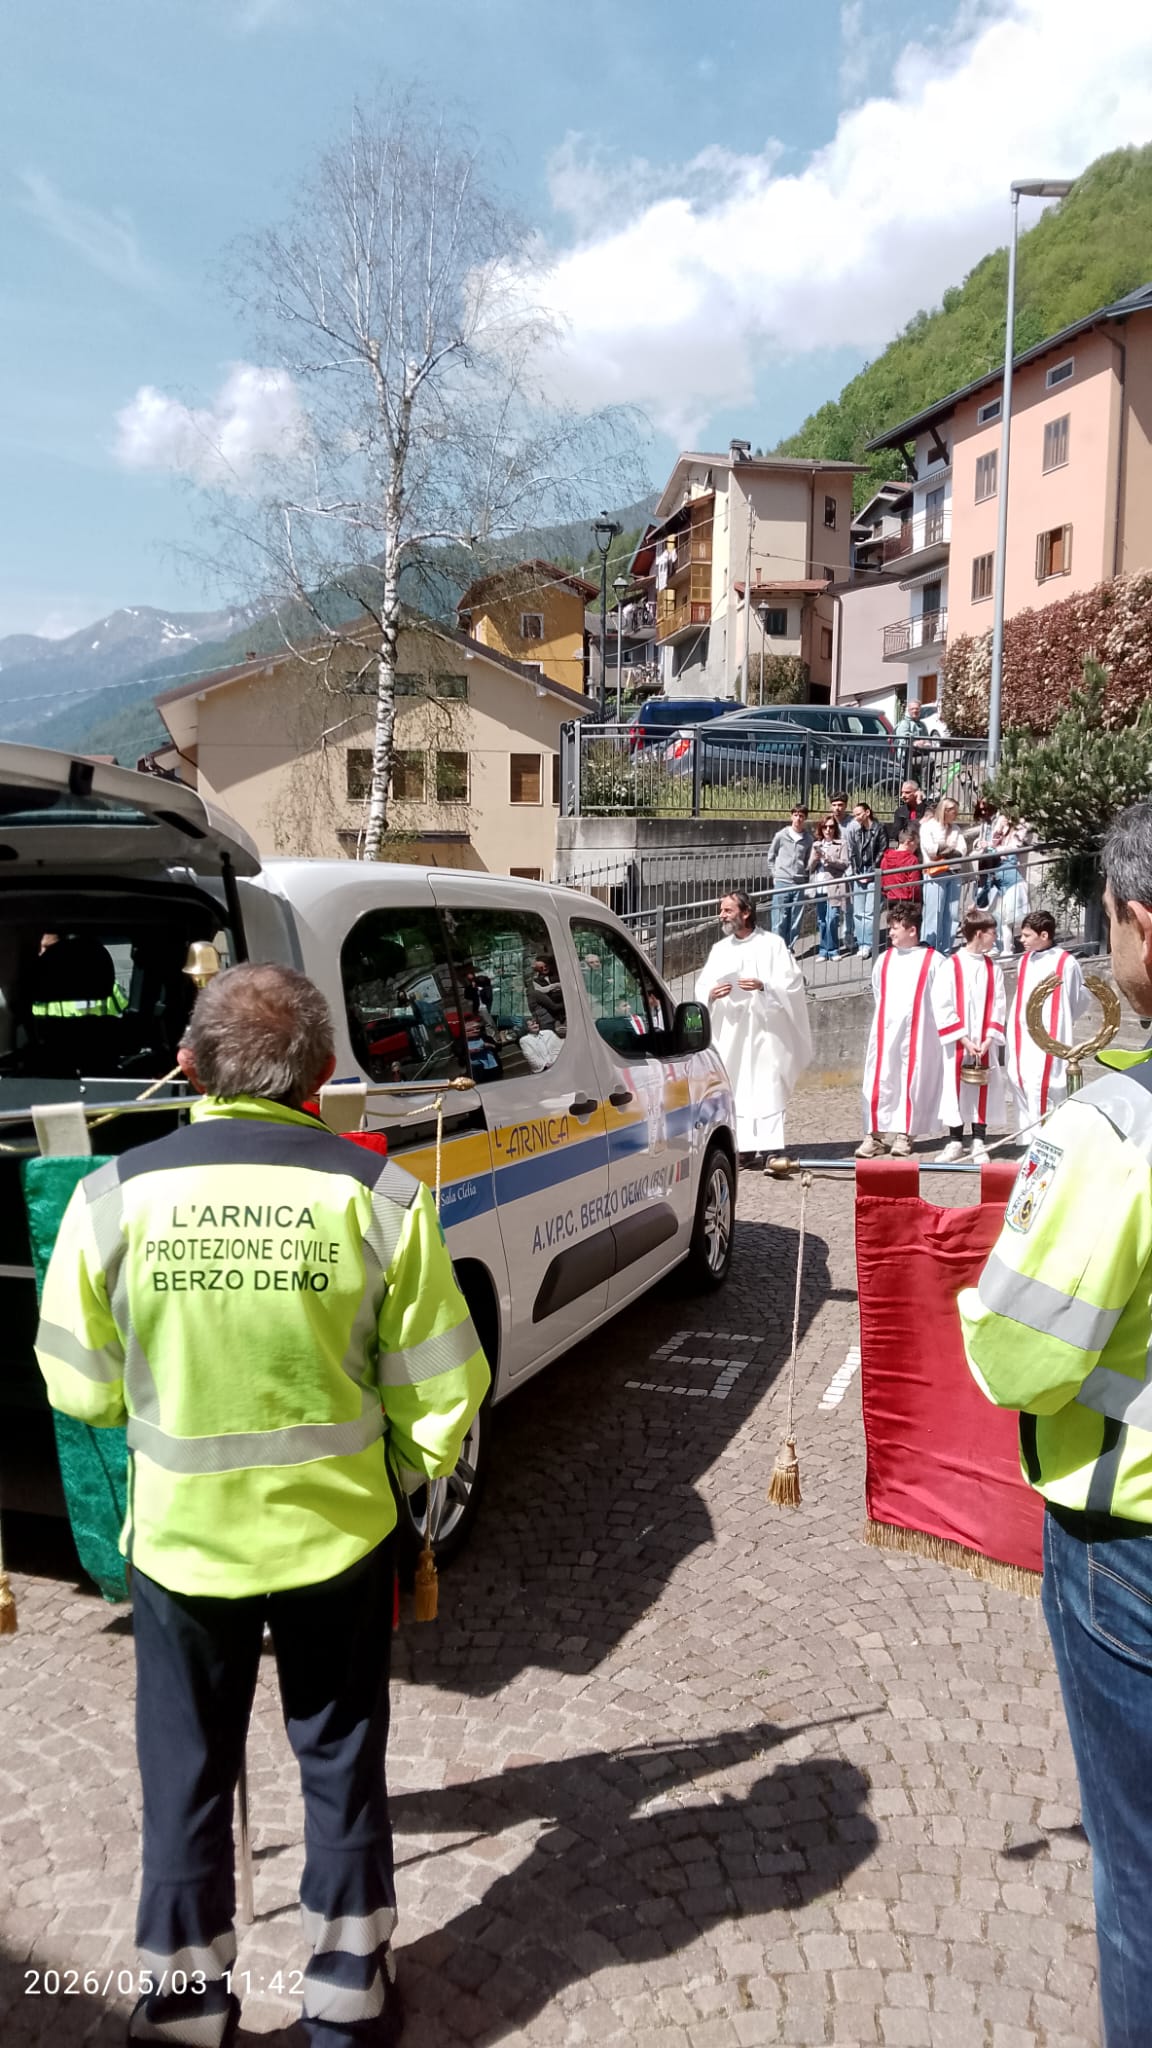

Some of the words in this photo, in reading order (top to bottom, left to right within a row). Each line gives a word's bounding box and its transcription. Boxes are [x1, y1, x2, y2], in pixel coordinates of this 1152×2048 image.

[172, 1205, 316, 1230] L'ARNICA
[532, 1210, 578, 1255] A.V.P.C.
[580, 1191, 618, 1230] BERZO
[621, 1175, 649, 1209] DEMO
[146, 1238, 274, 1261] PROTEZIONE
[280, 1238, 340, 1264] CIVILE
[153, 1269, 244, 1291] BERZO
[254, 1270, 329, 1292] DEMO
